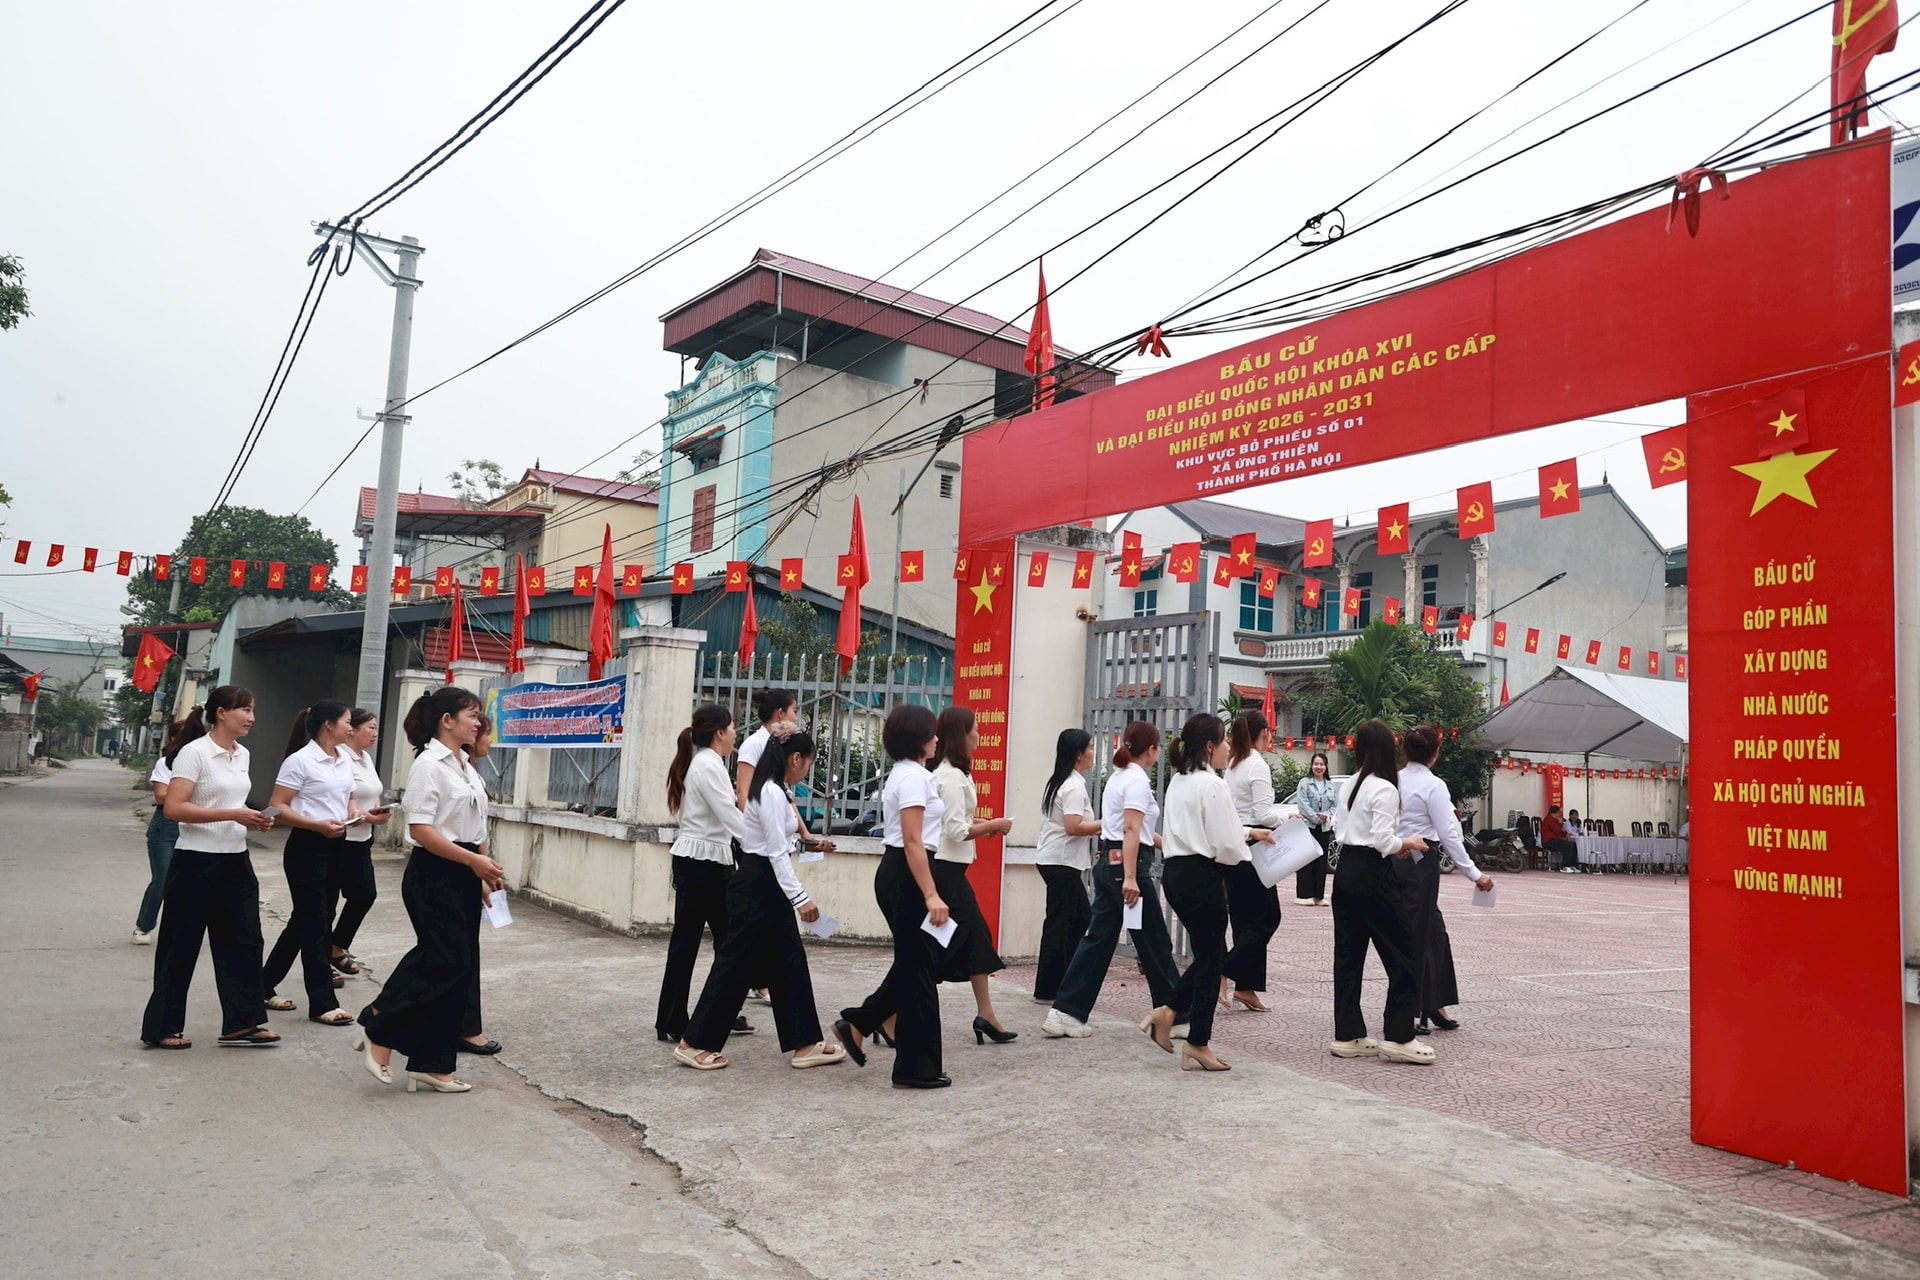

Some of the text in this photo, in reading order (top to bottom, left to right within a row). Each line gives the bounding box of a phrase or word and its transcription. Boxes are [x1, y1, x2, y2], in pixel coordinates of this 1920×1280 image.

[1220, 335, 1319, 380] BẦU CỬ
[1096, 332, 1496, 454] VÀ ĐẠI BIỂU HỘI ĐỒNG NHÂN DÂN CÁC CẤP
[1145, 333, 1413, 423] ĐẠI BIỂU QUỐC HỘI KHÓA XVI
[1169, 429, 1225, 456] NHIỆM
[1229, 421, 1253, 440] KỲ
[1256, 410, 1304, 434] 2026
[1322, 391, 1373, 417] 2031
[1175, 415, 1364, 470] KHU VỰC BỎ PHIẾU SỐ 01
[1211, 441, 1320, 475] XÃ ỨNG THIÊN
[1196, 452, 1342, 491] THÀNH PHỐ HÀ NỘI
[1754, 554, 1816, 587] BẦU CỬ
[1743, 598, 1828, 631] GÓP PHẦN
[1743, 648, 1828, 676] XÂY DỰNG
[1743, 690, 1829, 716] NHÀ NƯỚC
[1734, 732, 1840, 762] PHÁP QUYỀN
[1713, 777, 1866, 808] XÃ HỘI CHỦ NGHĨA
[1747, 823, 1827, 853] VIỆT NAM
[1734, 866, 1843, 900] VỮNG MẠNH!
